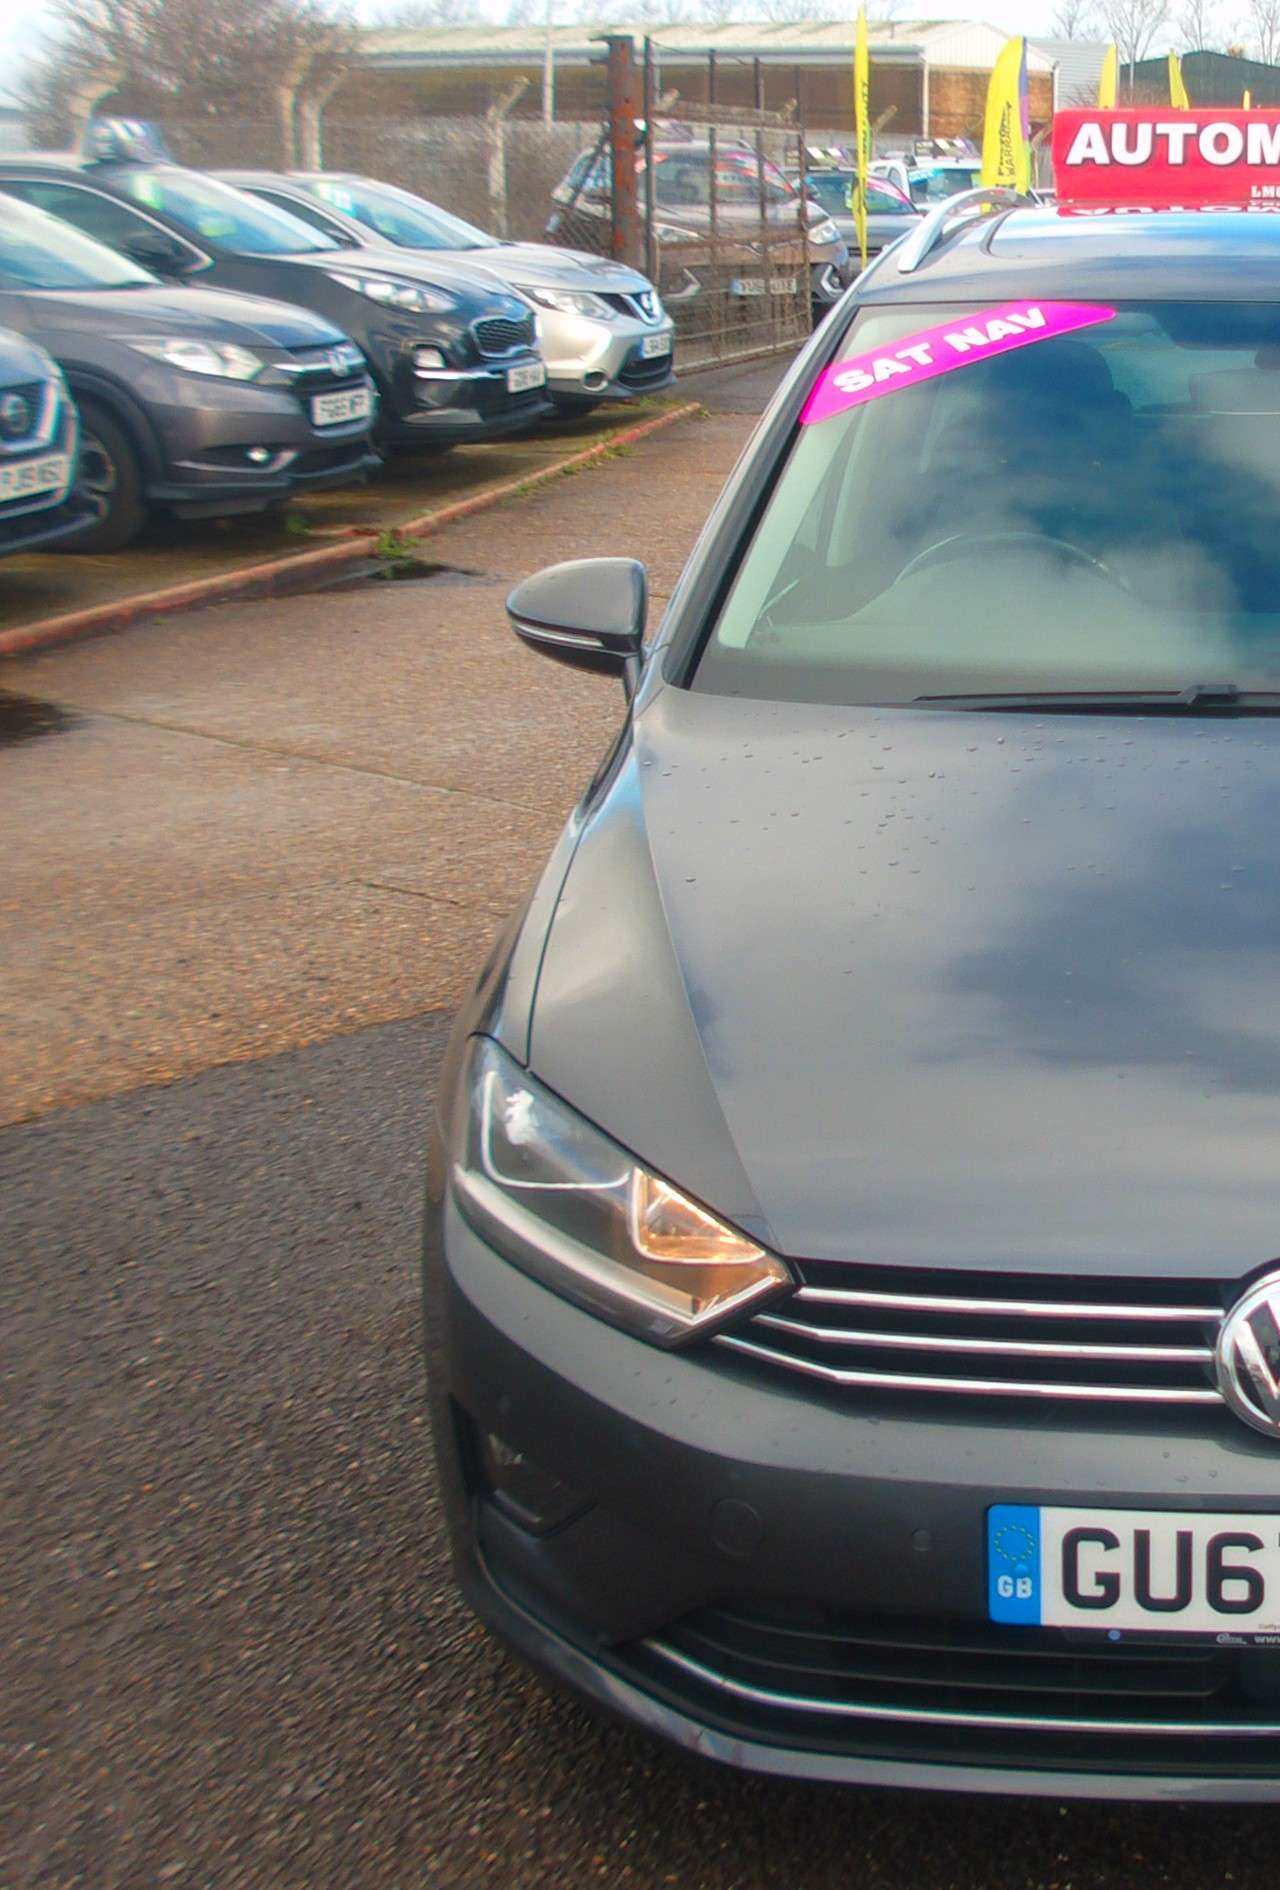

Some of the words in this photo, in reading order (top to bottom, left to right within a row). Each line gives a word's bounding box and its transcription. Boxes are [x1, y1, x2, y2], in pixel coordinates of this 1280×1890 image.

[832, 342, 934, 393] SAT
[943, 306, 1047, 353] NAV
[997, 1575, 1033, 1599] GB
